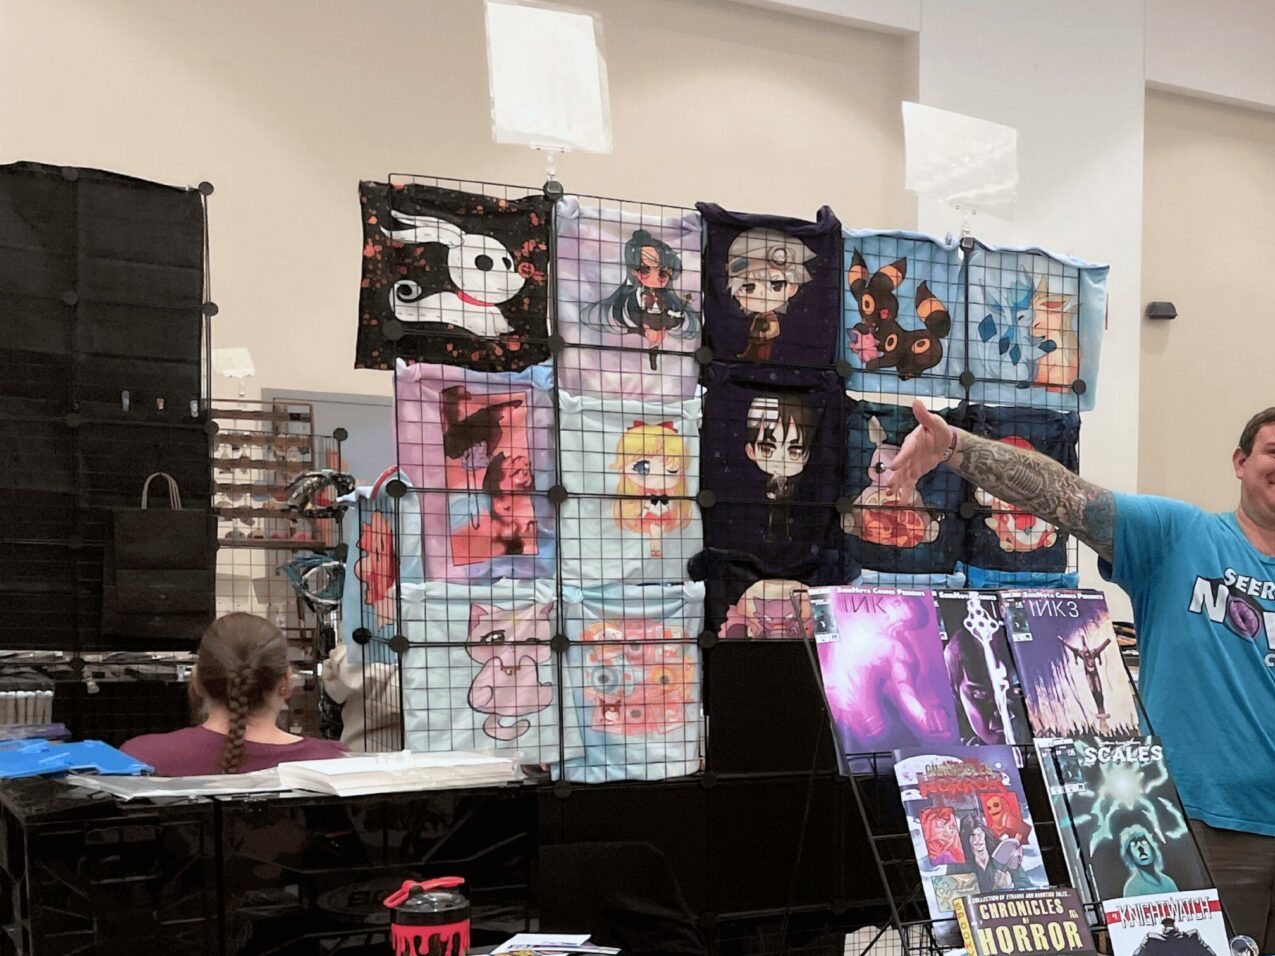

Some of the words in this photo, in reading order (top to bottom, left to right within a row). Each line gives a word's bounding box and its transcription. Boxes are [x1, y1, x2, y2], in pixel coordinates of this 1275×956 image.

[1224, 567, 1275, 600] SEER
[1084, 745, 1163, 763] SCALES
[979, 898, 1064, 920] CHRONICLES
[977, 921, 1084, 956] HORROR
